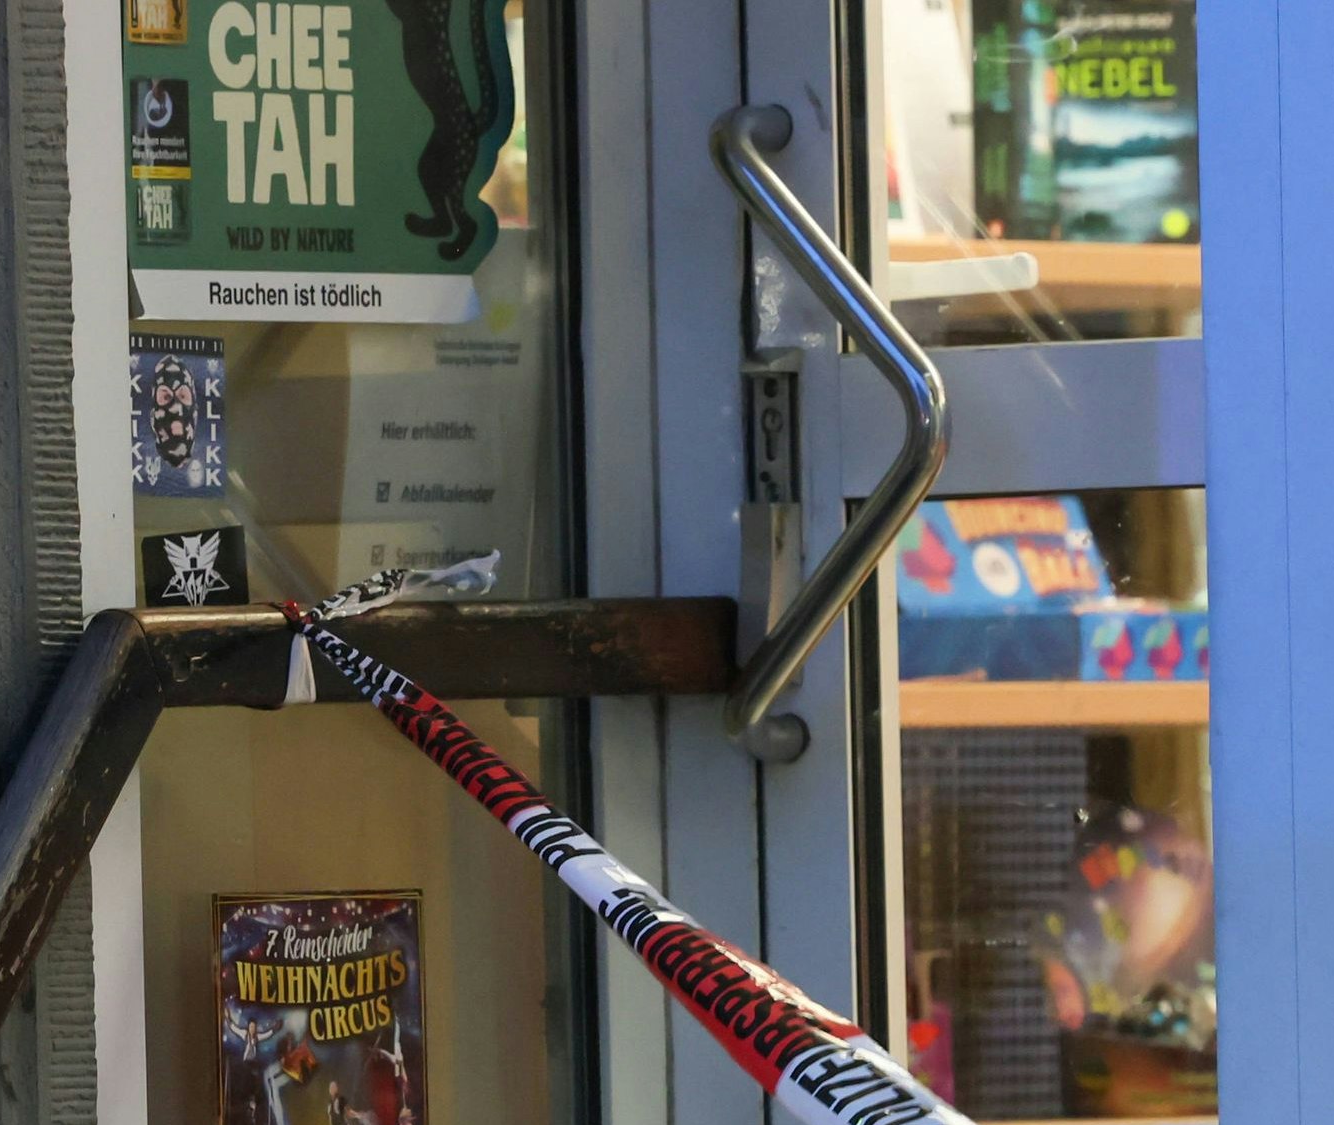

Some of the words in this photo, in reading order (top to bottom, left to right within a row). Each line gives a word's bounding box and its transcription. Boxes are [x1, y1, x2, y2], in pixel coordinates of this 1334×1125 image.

[208, 1, 353, 91] CHEE
[213, 91, 355, 206] TAH
[145, 203, 173, 230] TAH
[226, 226, 264, 251] WILD
[270, 227, 290, 251] BY
[297, 227, 355, 253] NATURE
[209, 281, 288, 305] Rauchen
[294, 283, 315, 306] ist
[321, 284, 381, 307] tödlich
[205, 378, 222, 486] KLIKK
[381, 421, 408, 440] Hier
[266, 929, 279, 958] 7.
[283, 923, 373, 962] Remscheider
[236, 949, 406, 1004] WEIHNACHTS
[310, 995, 391, 1041] CIRCUS
